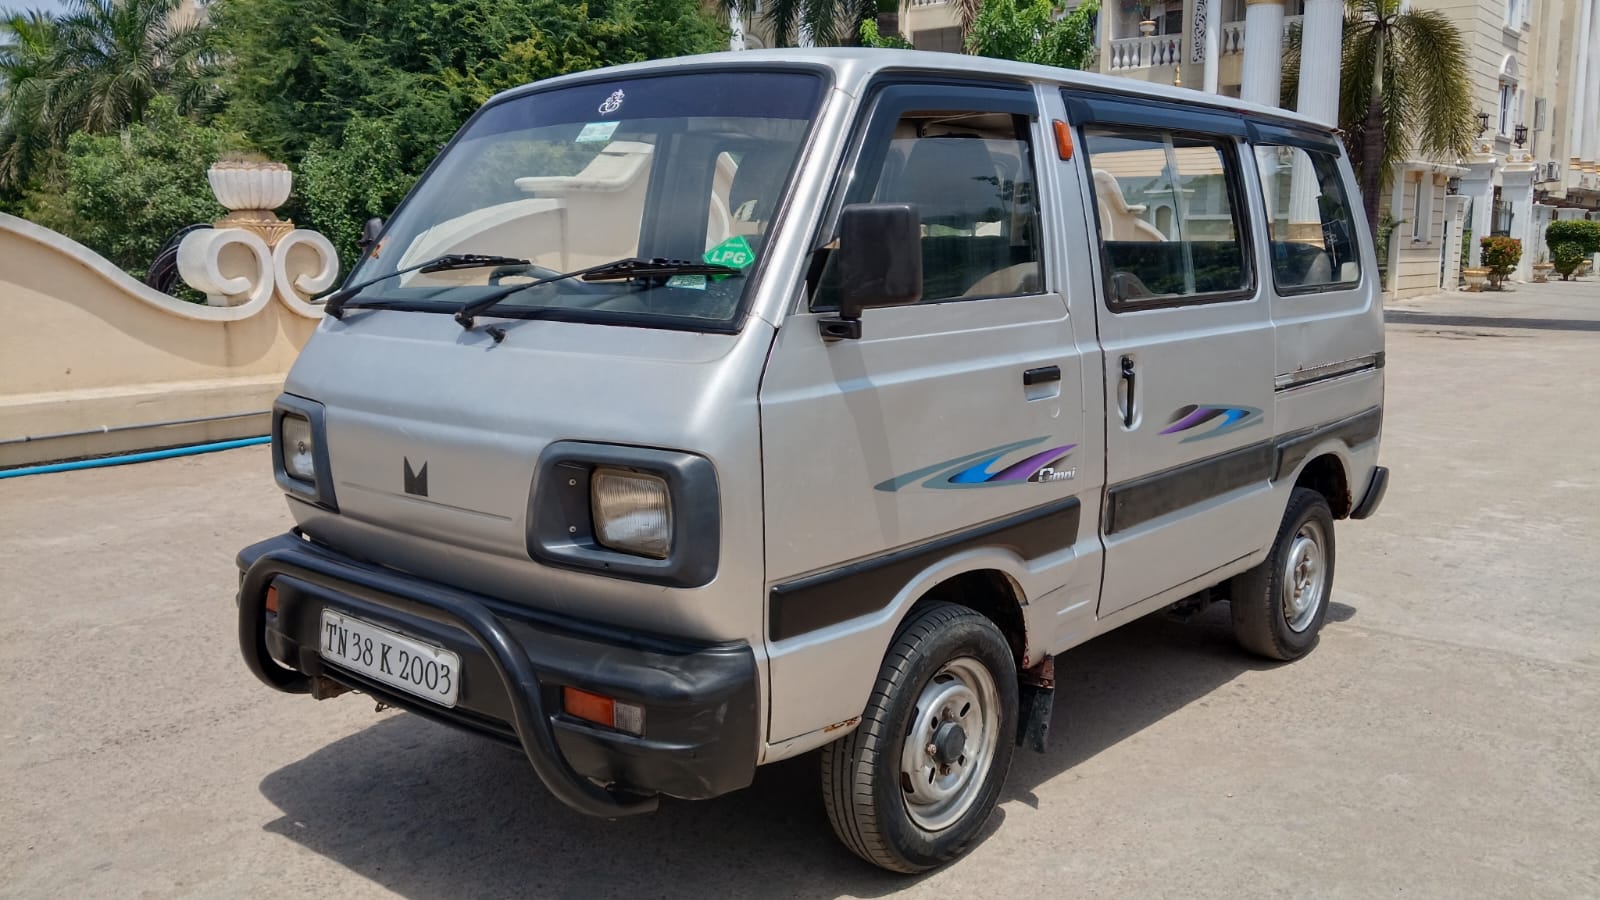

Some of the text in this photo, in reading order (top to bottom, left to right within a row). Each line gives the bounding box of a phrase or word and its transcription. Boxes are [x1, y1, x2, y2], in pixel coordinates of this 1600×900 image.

[711, 250, 746, 265] LPG
[1038, 466, 1076, 483] Omni
[326, 622, 451, 695] TN 38 K 2003
